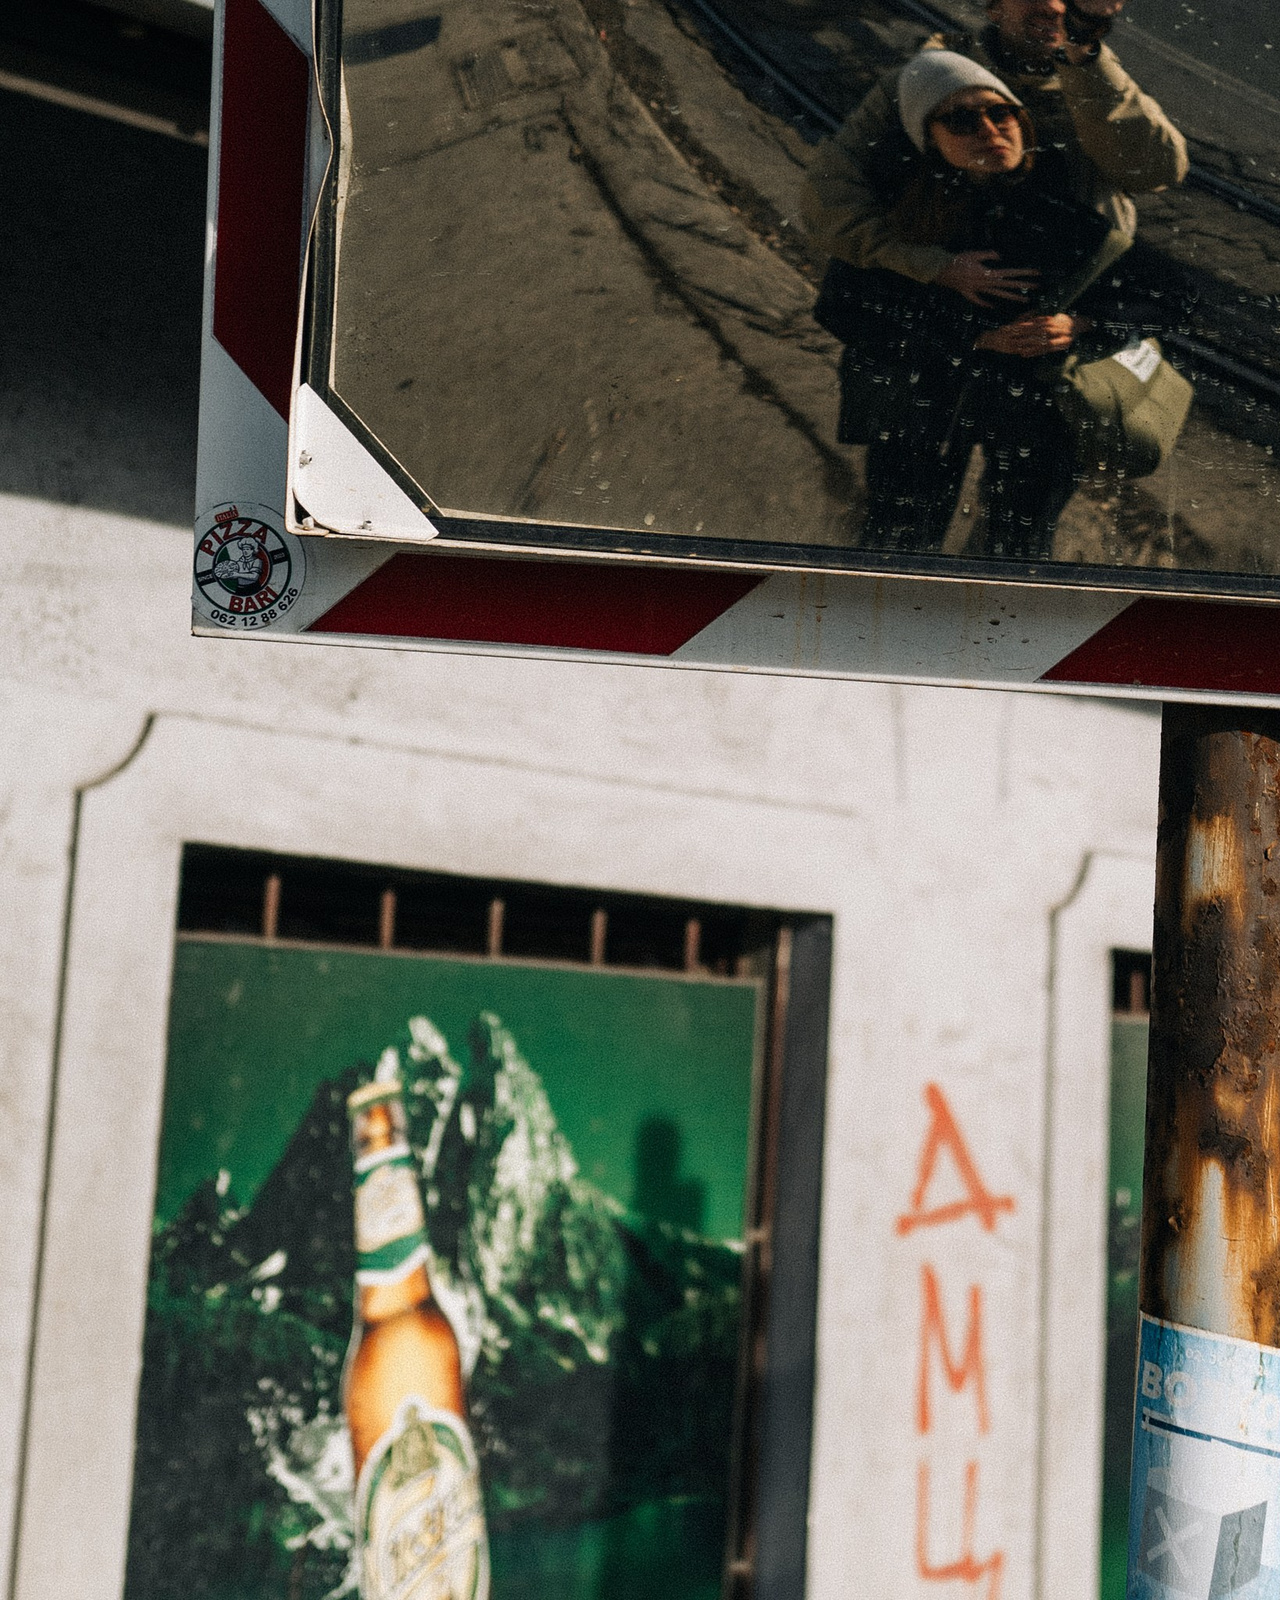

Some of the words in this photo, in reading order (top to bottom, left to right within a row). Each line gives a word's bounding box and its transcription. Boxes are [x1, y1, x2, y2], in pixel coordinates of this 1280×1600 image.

[215, 509, 239, 522] ITALIA
[200, 520, 269, 556] PIZZA
[197, 573, 213, 583] SINCE
[210, 609, 236, 626] 062
[241, 616, 258, 627] 12
[261, 608, 277, 623] 88
[278, 587, 298, 611] 626
[229, 585, 279, 613] BARI
